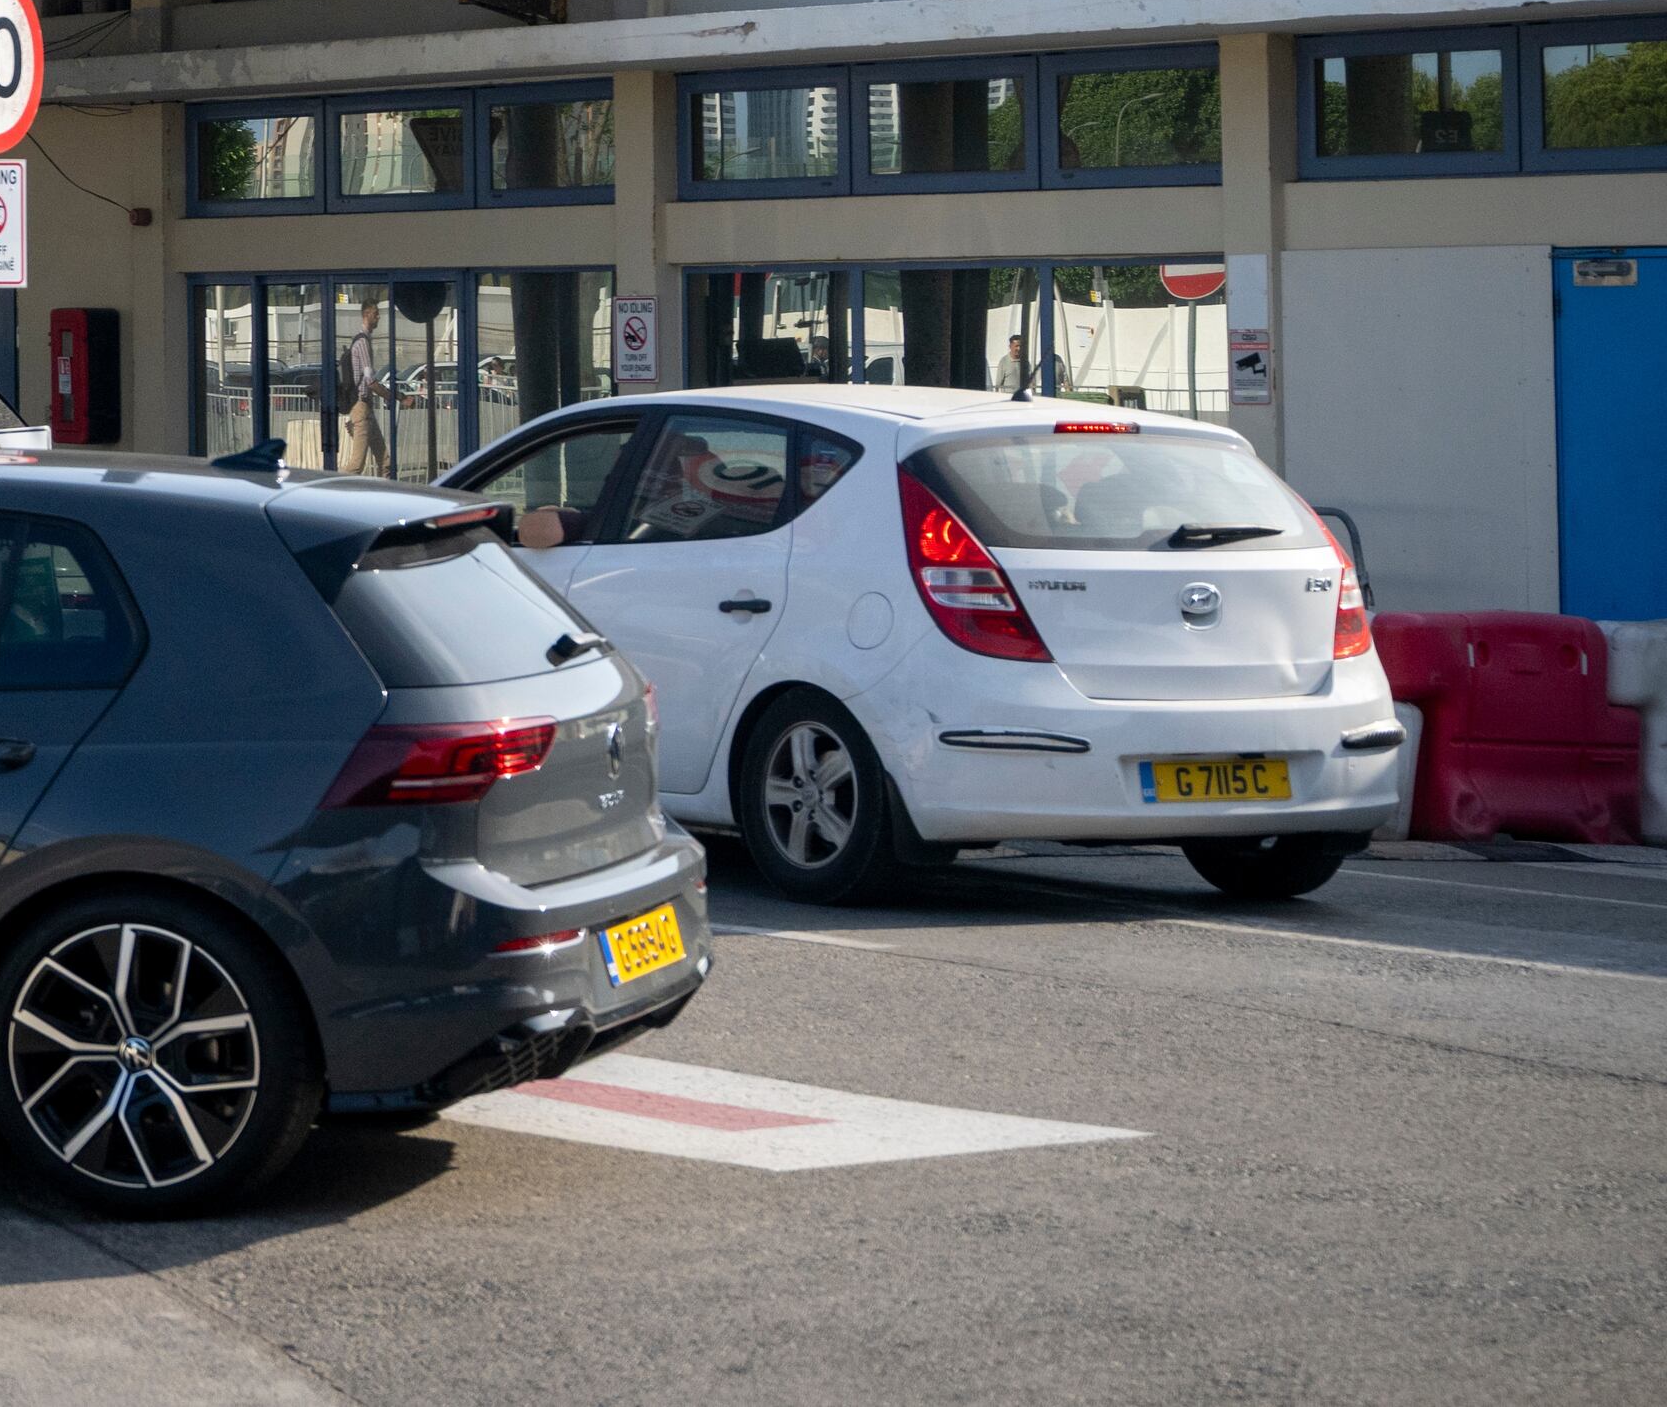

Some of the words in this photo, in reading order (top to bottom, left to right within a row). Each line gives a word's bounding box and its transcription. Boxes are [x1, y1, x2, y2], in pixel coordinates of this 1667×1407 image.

[618, 303, 628, 313] NO
[1176, 767, 1193, 796] G
[1252, 764, 1269, 793] C
